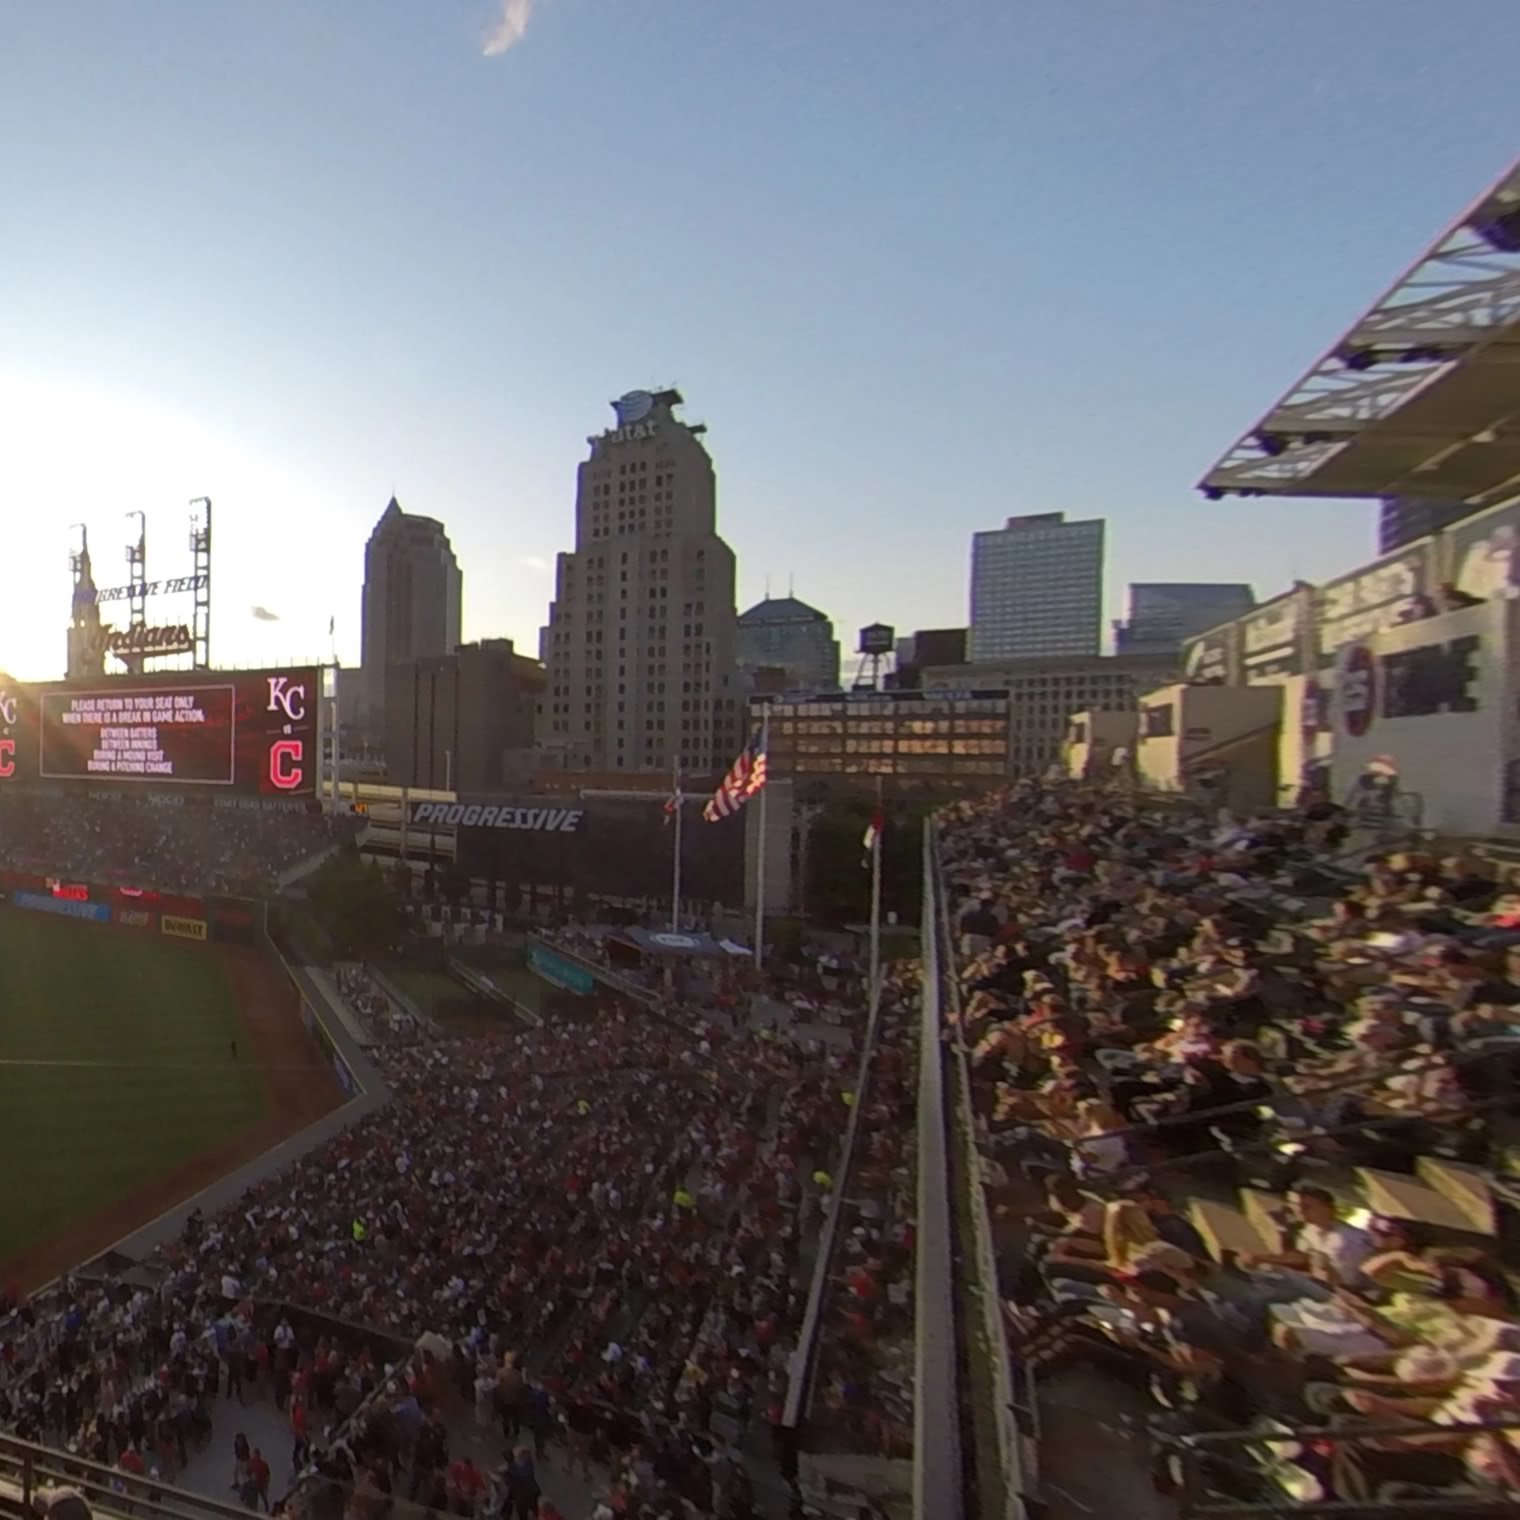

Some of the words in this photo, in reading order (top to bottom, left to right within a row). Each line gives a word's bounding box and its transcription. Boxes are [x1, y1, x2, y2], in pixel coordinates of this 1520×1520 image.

[71, 699, 95, 711] PLEASE
[97, 699, 123, 710] RETURN
[125, 698, 133, 709] TO
[134, 698, 154, 709] YOUR
[155, 697, 173, 709] SEAT
[174, 696, 194, 708] ONLY
[266, 677, 305, 720] KC
[62, 713, 81, 724] WHEN
[82, 712, 103, 723] THERE
[104, 712, 111, 723] IS
[112, 712, 117, 723] A
[118, 712, 141, 723] BREAK
[142, 711, 151, 723] IN
[152, 711, 173, 723] GAME
[100, 728, 129, 739] BETWEEN
[130, 727, 157, 739] BATTERS
[101, 740, 129, 750] BETWEEN
[93, 750, 116, 761] DURING
[147, 750, 164, 761] VISIT
[87, 760, 110, 772] DURING
[116, 761, 145, 773] PITCHING
[145, 761, 173, 774] CHANGE
[270, 740, 303, 788] C
[413, 803, 584, 832] PROGRESSIVE
